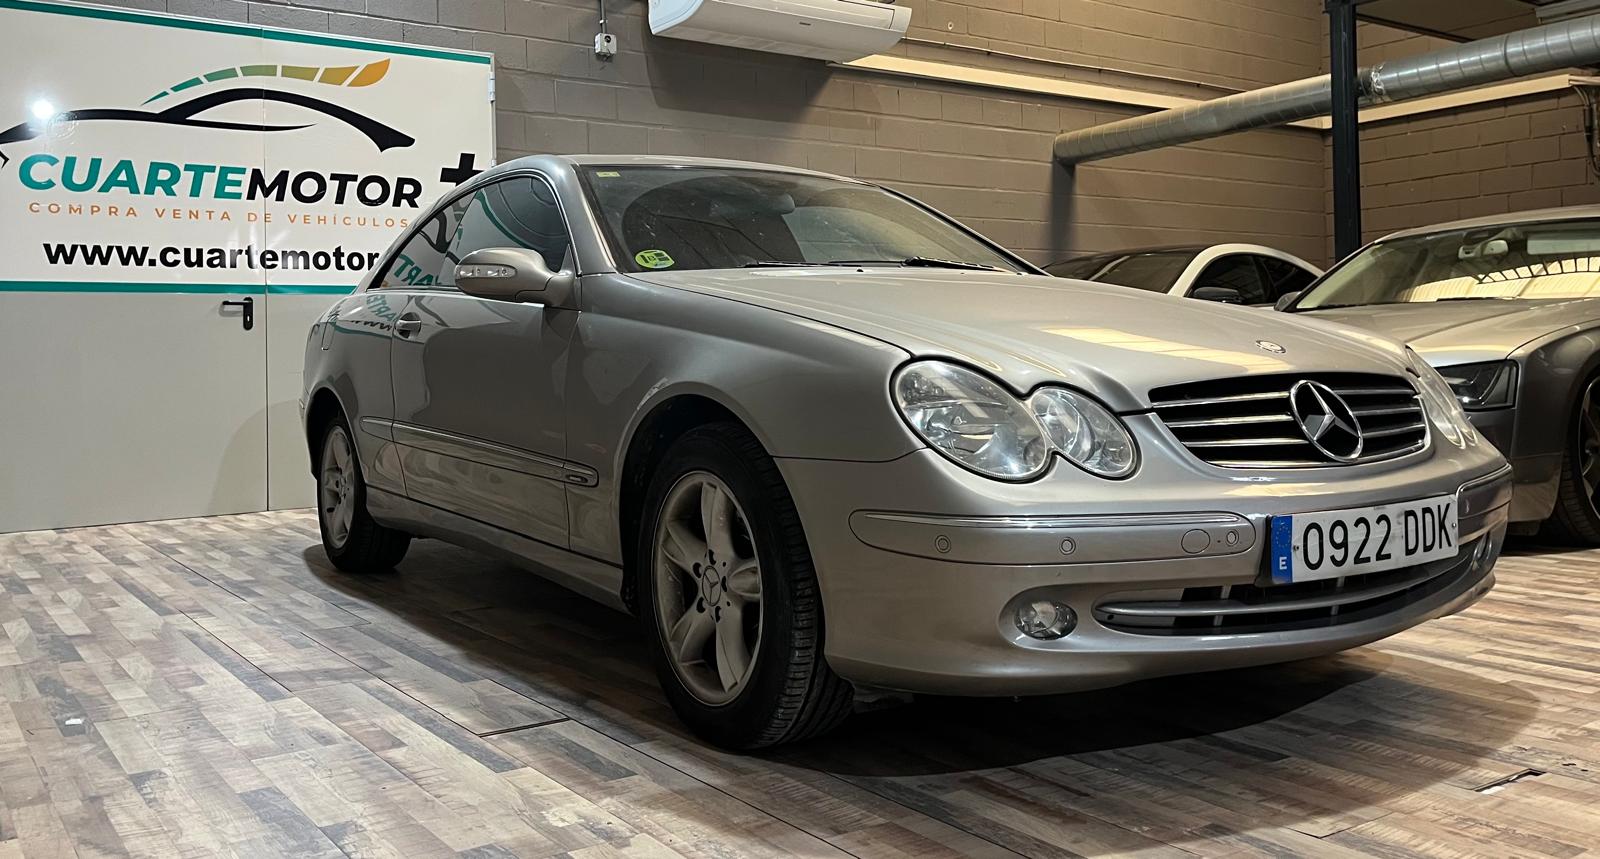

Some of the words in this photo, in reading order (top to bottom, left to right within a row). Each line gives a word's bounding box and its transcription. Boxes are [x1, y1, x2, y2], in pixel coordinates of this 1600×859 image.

[19, 154, 423, 208] CUARTEMOTOR
[28, 202, 138, 217] COMPRA
[155, 208, 231, 221] VENTA
[247, 213, 272, 223] DE
[288, 214, 409, 228] VEHÍCULOS
[1302, 514, 1392, 571] 0922
[1404, 502, 1452, 556] DDK
[1279, 556, 1288, 570] E
